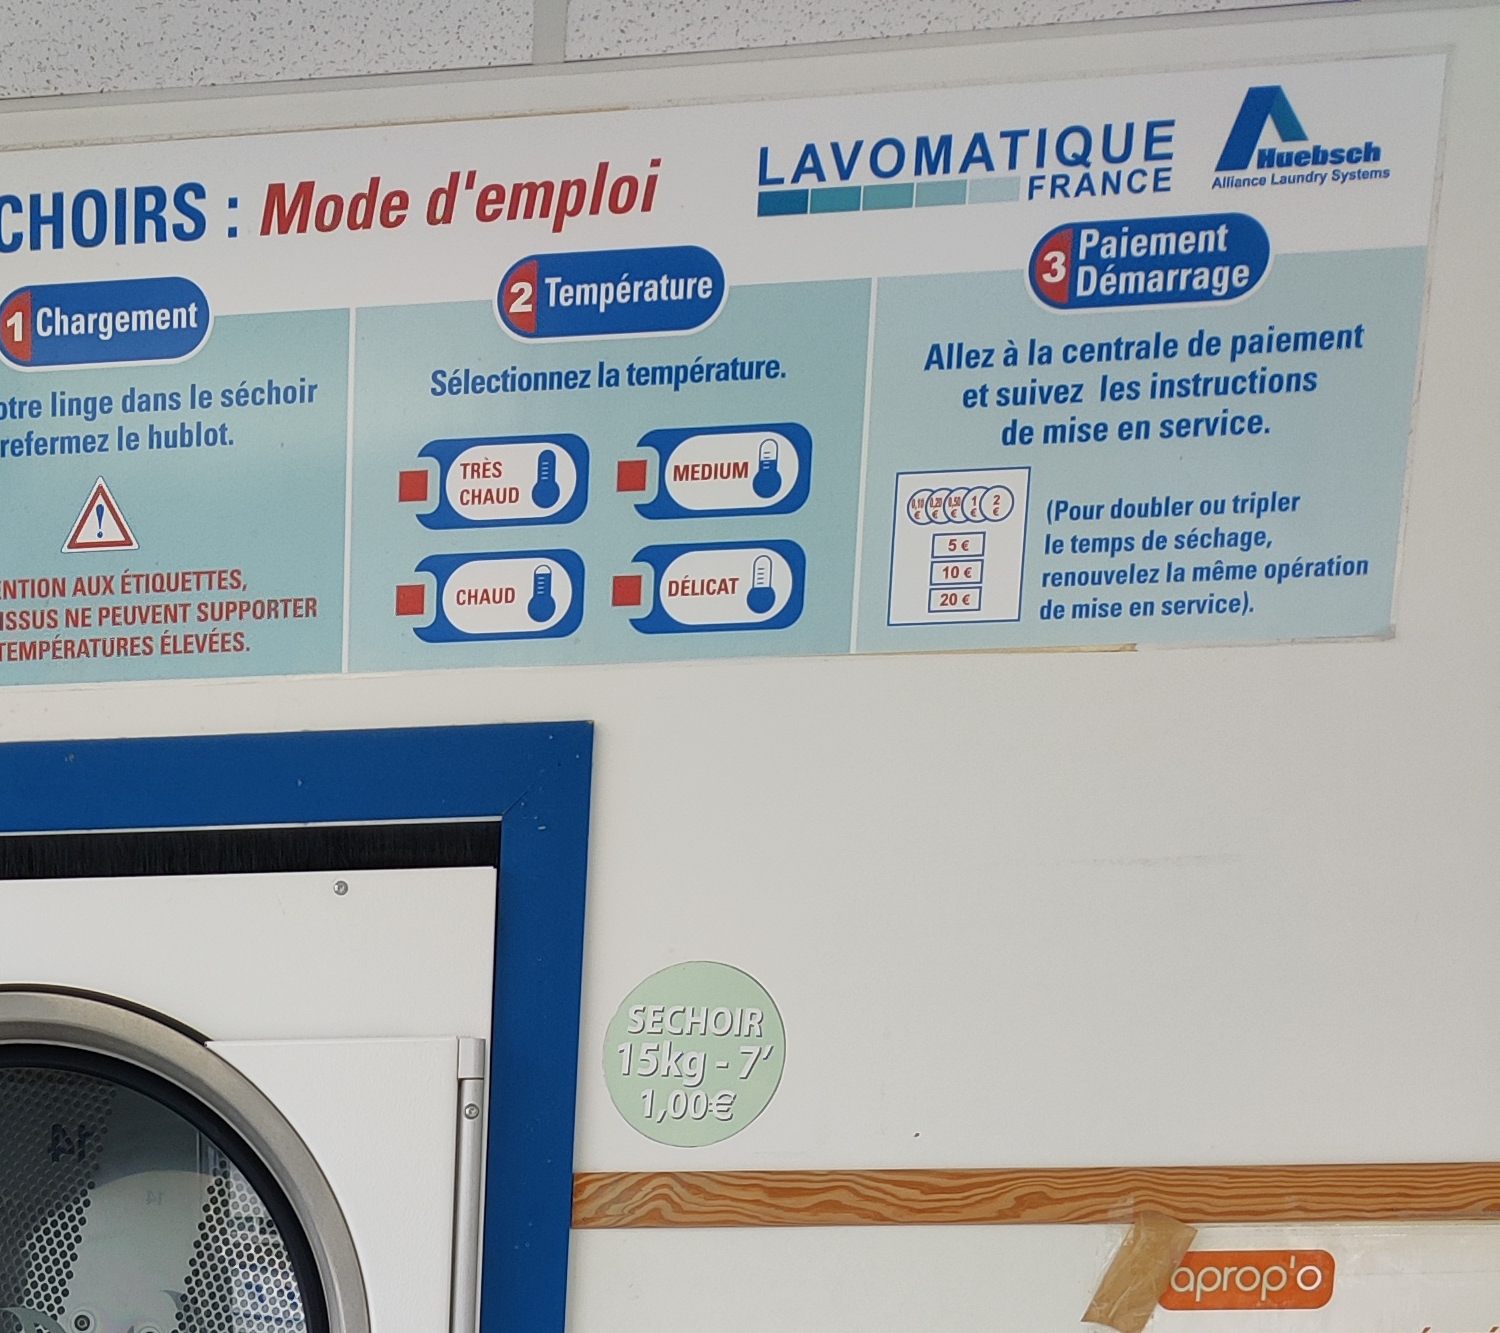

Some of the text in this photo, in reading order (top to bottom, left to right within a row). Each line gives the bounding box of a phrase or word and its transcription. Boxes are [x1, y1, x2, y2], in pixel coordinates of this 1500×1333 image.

[757, 119, 1177, 186] LAVOMATIQUE
[1256, 142, 1381, 170] Huebsch
[1027, 167, 1173, 200] FRANCE
[1211, 167, 1390, 191] Alliance Laundry Systems
[260, 177, 409, 237] Mode
[427, 158, 662, 234] d'emploi
[1078, 224, 1229, 260] Paiement
[1041, 251, 1066, 284] 3
[1076, 262, 1251, 298] Démarrage
[509, 269, 713, 314] 2 Température
[5, 301, 199, 342] 1 Chargement
[923, 324, 1365, 371] Allez à la centrale de paiement
[430, 356, 786, 397] Sélectionnez la température.
[962, 366, 1318, 408] et suivez les instructions
[50, 391, 113, 422] linge
[121, 387, 181, 413] dans
[190, 383, 213, 410] le
[220, 378, 318, 408] séchoir
[0, 430, 109, 458] refermez
[118, 426, 139, 451] le
[148, 420, 234, 450] hublot.
[1001, 408, 1270, 446] de mise en service.
[460, 457, 503, 480] TRÈS
[673, 461, 749, 482] MEDIUM
[459, 486, 519, 506] CHAUD
[1046, 491, 1301, 525] (Pour doubler ou tripler
[948, 539, 957, 552] 5
[1044, 527, 1273, 558] le temps de séchage,
[71, 575, 114, 598] AUX
[121, 568, 248, 595] ÉTIQUETTES,
[668, 575, 740, 597] DÉLICAT
[942, 566, 959, 580] 10
[1042, 555, 1369, 587] renouvelez la même opération
[65, 607, 92, 628] NE
[98, 603, 191, 627] PEUVENT
[197, 597, 318, 622] SUPPORTER
[455, 587, 516, 606] CHAUD
[940, 593, 958, 606] 20
[1040, 591, 1254, 620] de mise en service).
[160, 628, 250, 655] ÉLEVÉES.
[627, 1004, 764, 1037] SECHOIR
[618, 1040, 707, 1087] 15kg
[641, 1089, 737, 1124] 1,00€
[1170, 1255, 1322, 1302] aprop'o
